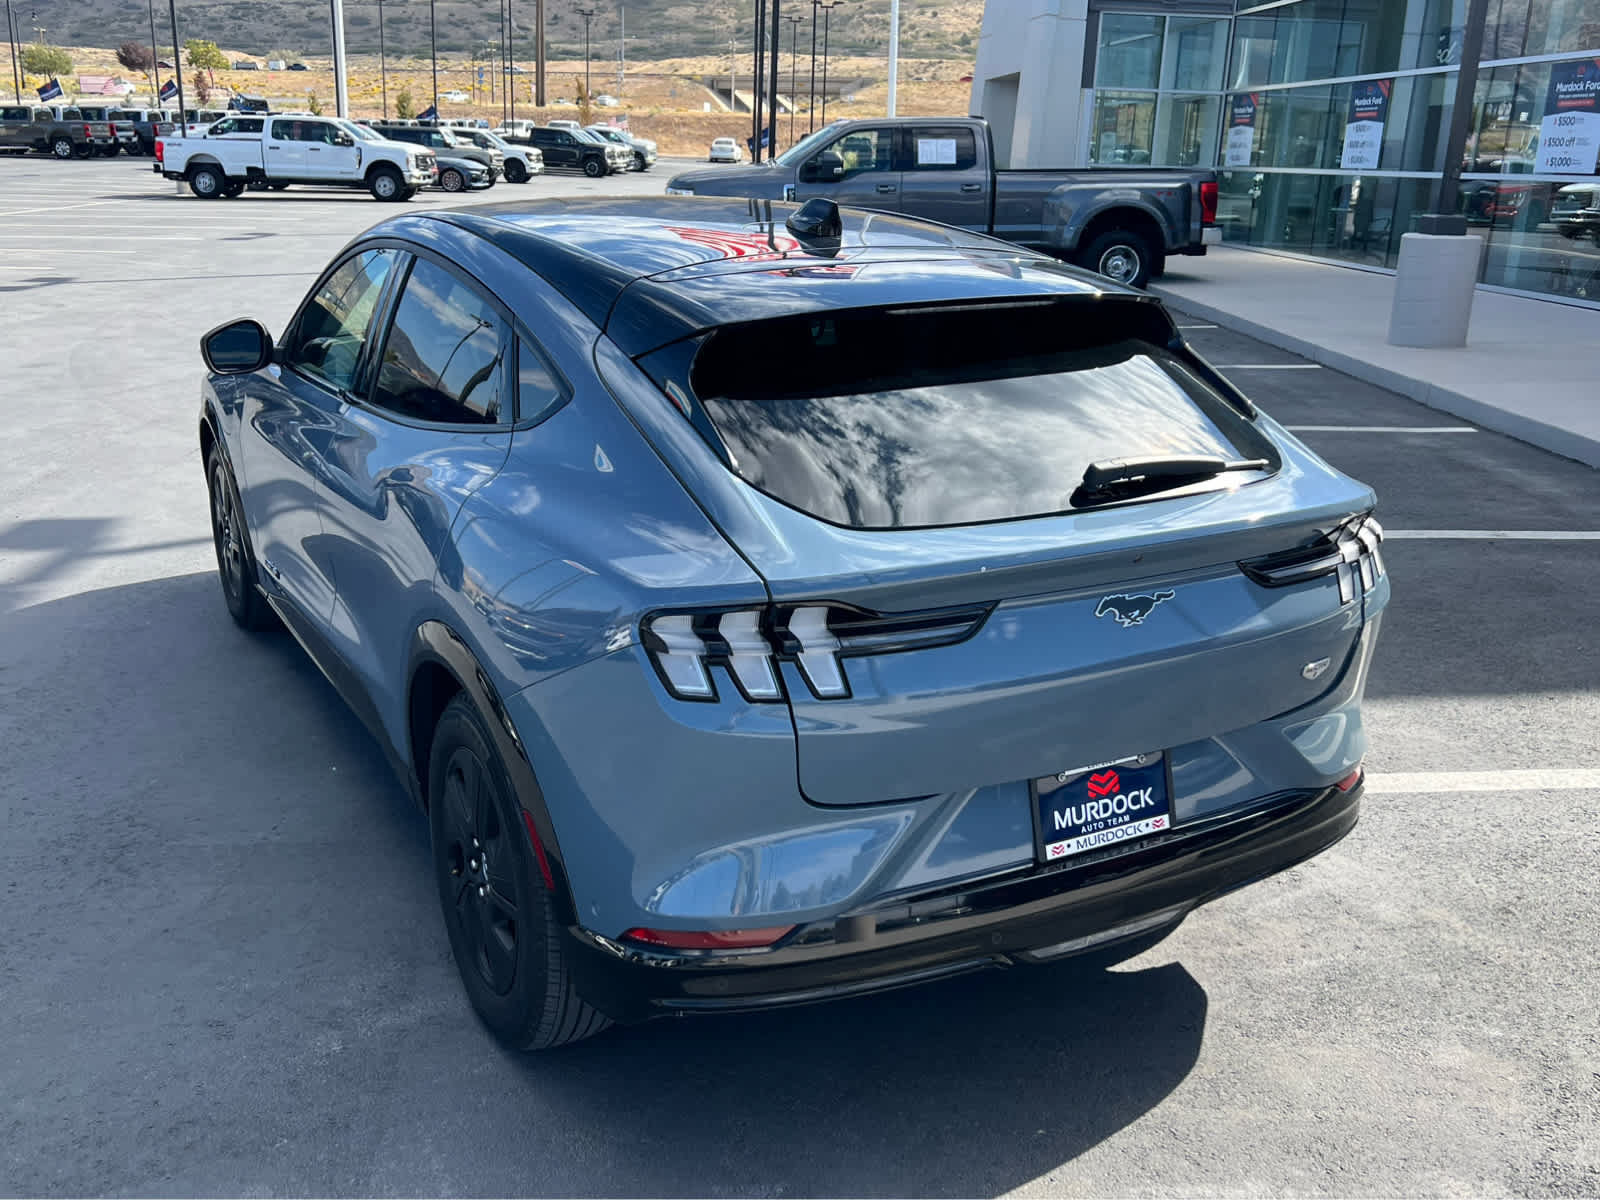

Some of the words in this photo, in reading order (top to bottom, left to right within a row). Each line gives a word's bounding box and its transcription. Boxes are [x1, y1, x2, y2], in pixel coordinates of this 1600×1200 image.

[1556, 81, 1584, 92] Murdock
[1558, 116, 1575, 126] $500
[1548, 137, 1564, 147] $500
[1054, 787, 1155, 830] MURDOCK
[1081, 822, 1105, 834] AUTO
[1107, 815, 1130, 827] TEAM
[1076, 823, 1143, 850] MURDOCK
